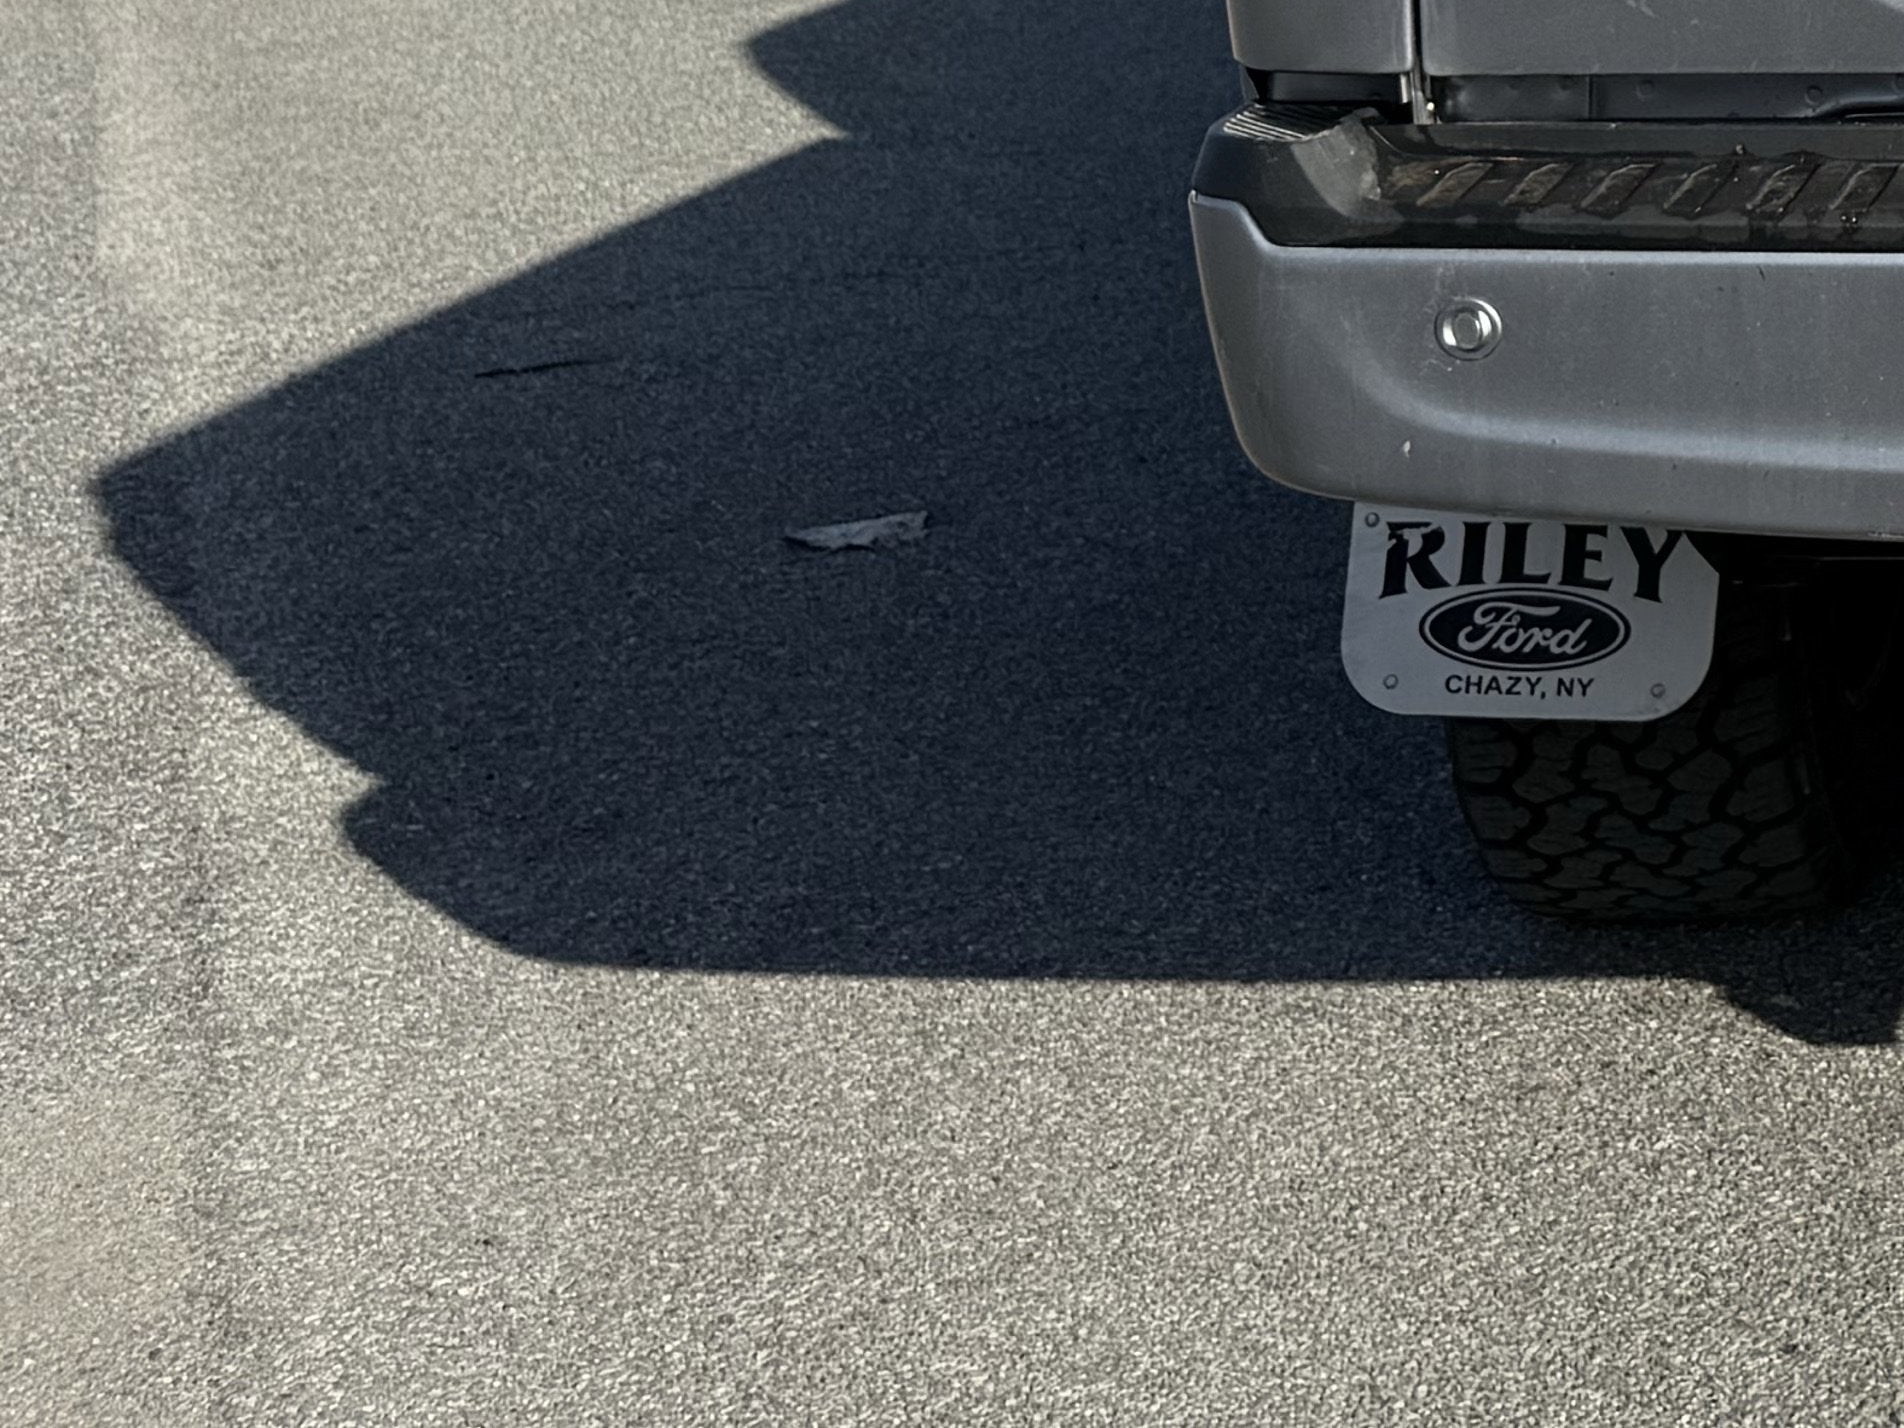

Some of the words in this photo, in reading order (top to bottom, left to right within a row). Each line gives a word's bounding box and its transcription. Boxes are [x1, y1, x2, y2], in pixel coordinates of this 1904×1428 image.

[1379, 521, 1686, 604] RILEY
[1457, 602, 1593, 654] Ford
[1445, 675, 1547, 700] CHAZY,
[1556, 676, 1595, 698] NY
